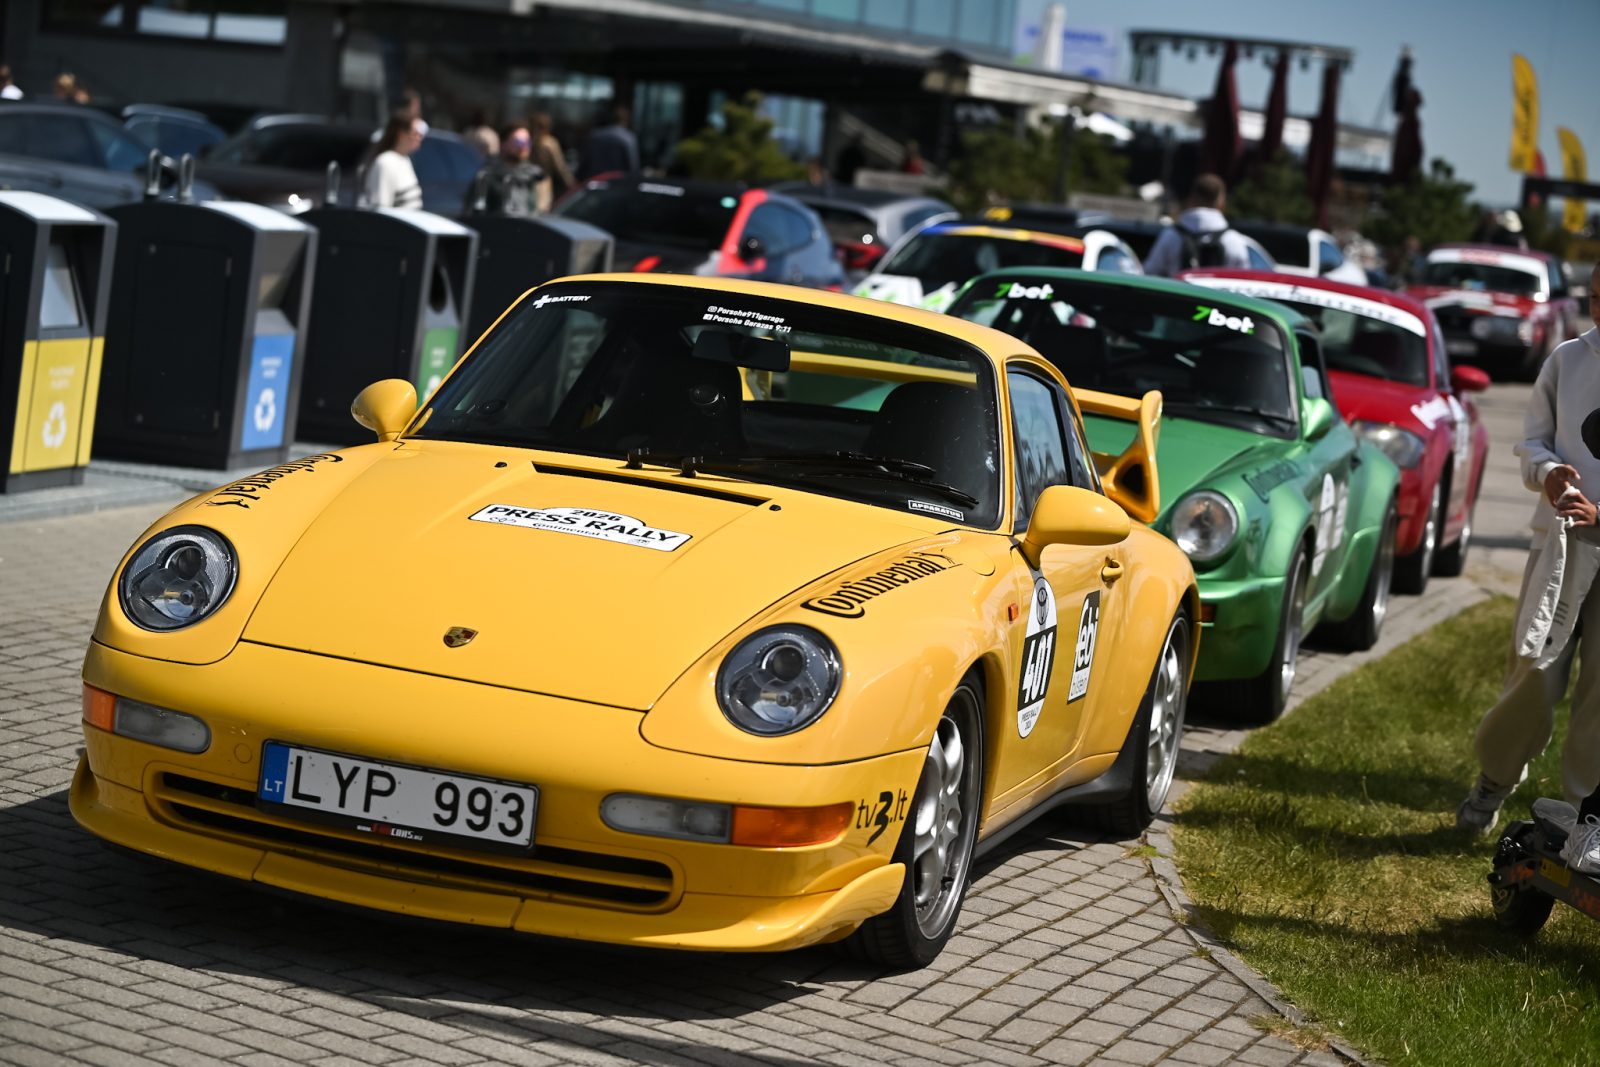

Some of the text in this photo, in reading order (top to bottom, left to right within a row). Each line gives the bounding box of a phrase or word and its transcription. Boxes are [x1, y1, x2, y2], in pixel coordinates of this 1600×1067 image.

[994, 283, 1053, 300] 7bet
[712, 315, 743, 325] Porsche
[775, 324, 792, 333] 9:11
[1192, 305, 1255, 334] 7bet
[213, 453, 344, 501] Continental
[487, 506, 679, 542] PRESS RALLY
[568, 509, 622, 521] 2026
[911, 502, 961, 518] APPARATUS
[800, 556, 947, 619] Continental
[1076, 598, 1099, 668] febi
[1022, 631, 1054, 704] 401
[264, 778, 283, 793] LT
[292, 755, 525, 838] LYP 993
[856, 788, 908, 848] tv3.lt
